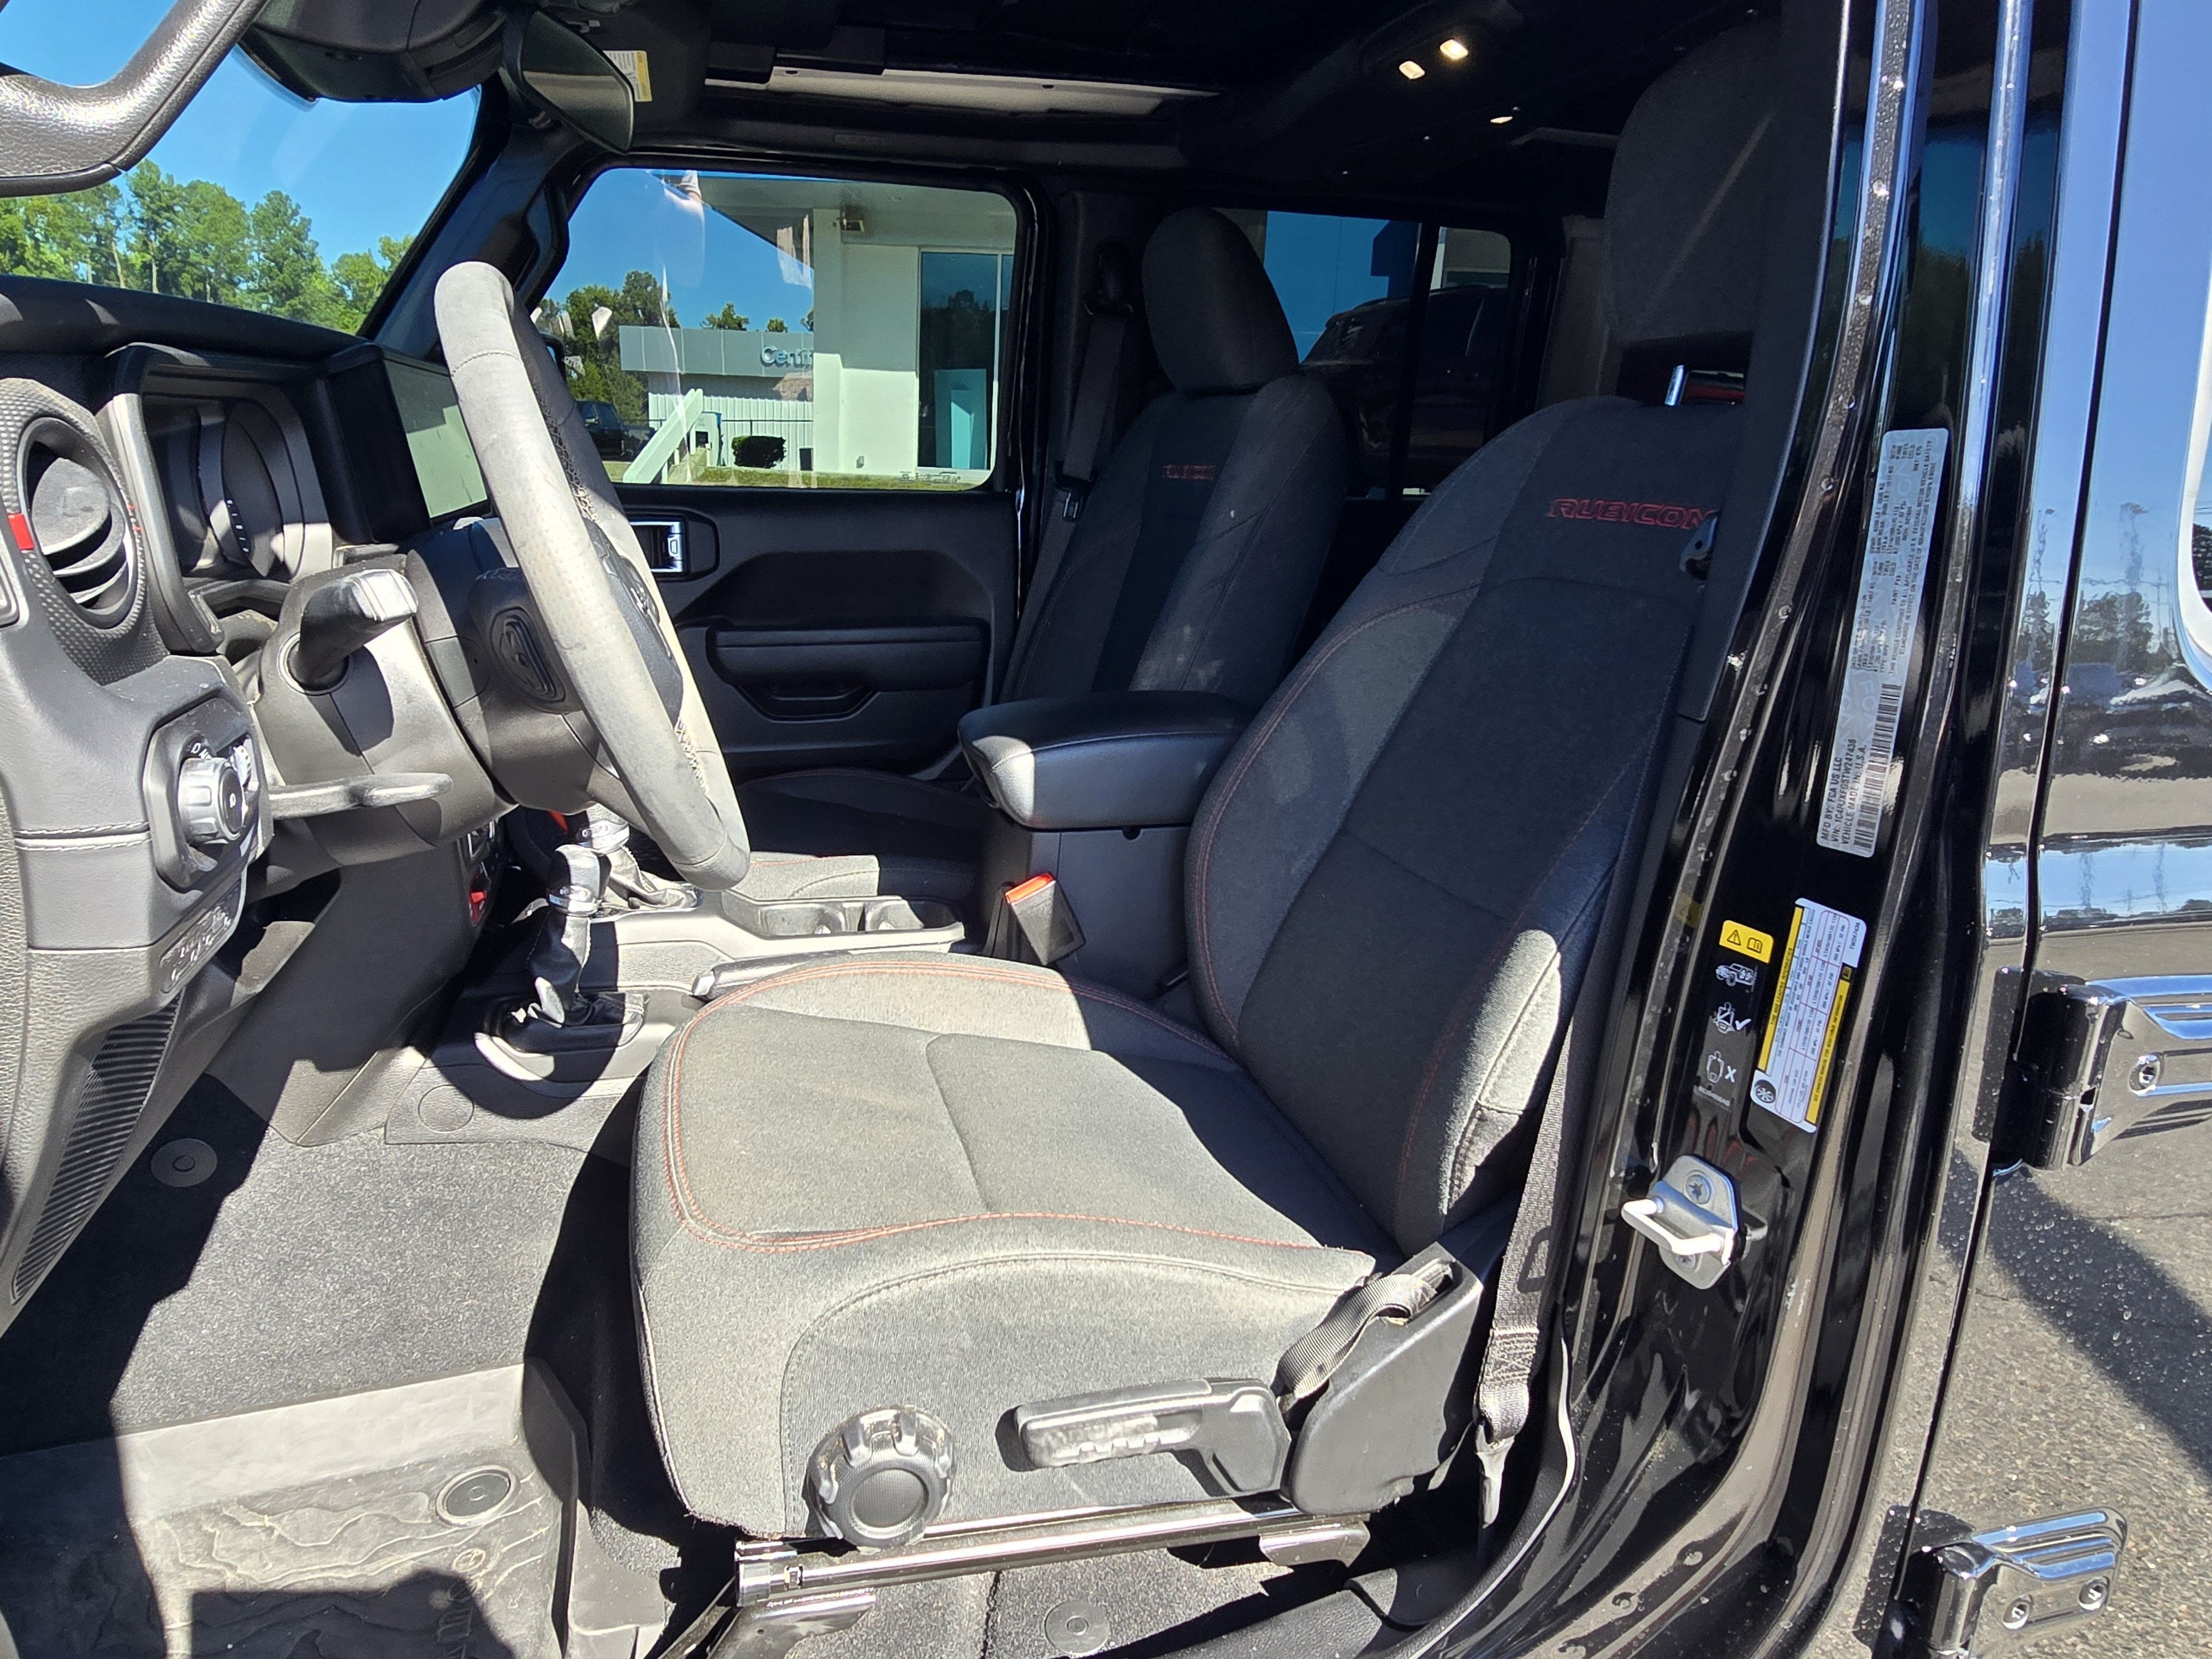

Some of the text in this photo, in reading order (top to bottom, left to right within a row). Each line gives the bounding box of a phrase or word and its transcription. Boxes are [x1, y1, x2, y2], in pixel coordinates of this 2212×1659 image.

[1546, 498, 1719, 529] RUBICON
[1832, 755, 1843, 772] LLC
[1830, 772, 1840, 785] US
[1827, 786, 1837, 804] FCA
[1840, 743, 1866, 846] VEHICLE MADE IN: U.S.A.
[1820, 821, 1831, 841] MFD
[1830, 825, 1841, 843] VIN:
